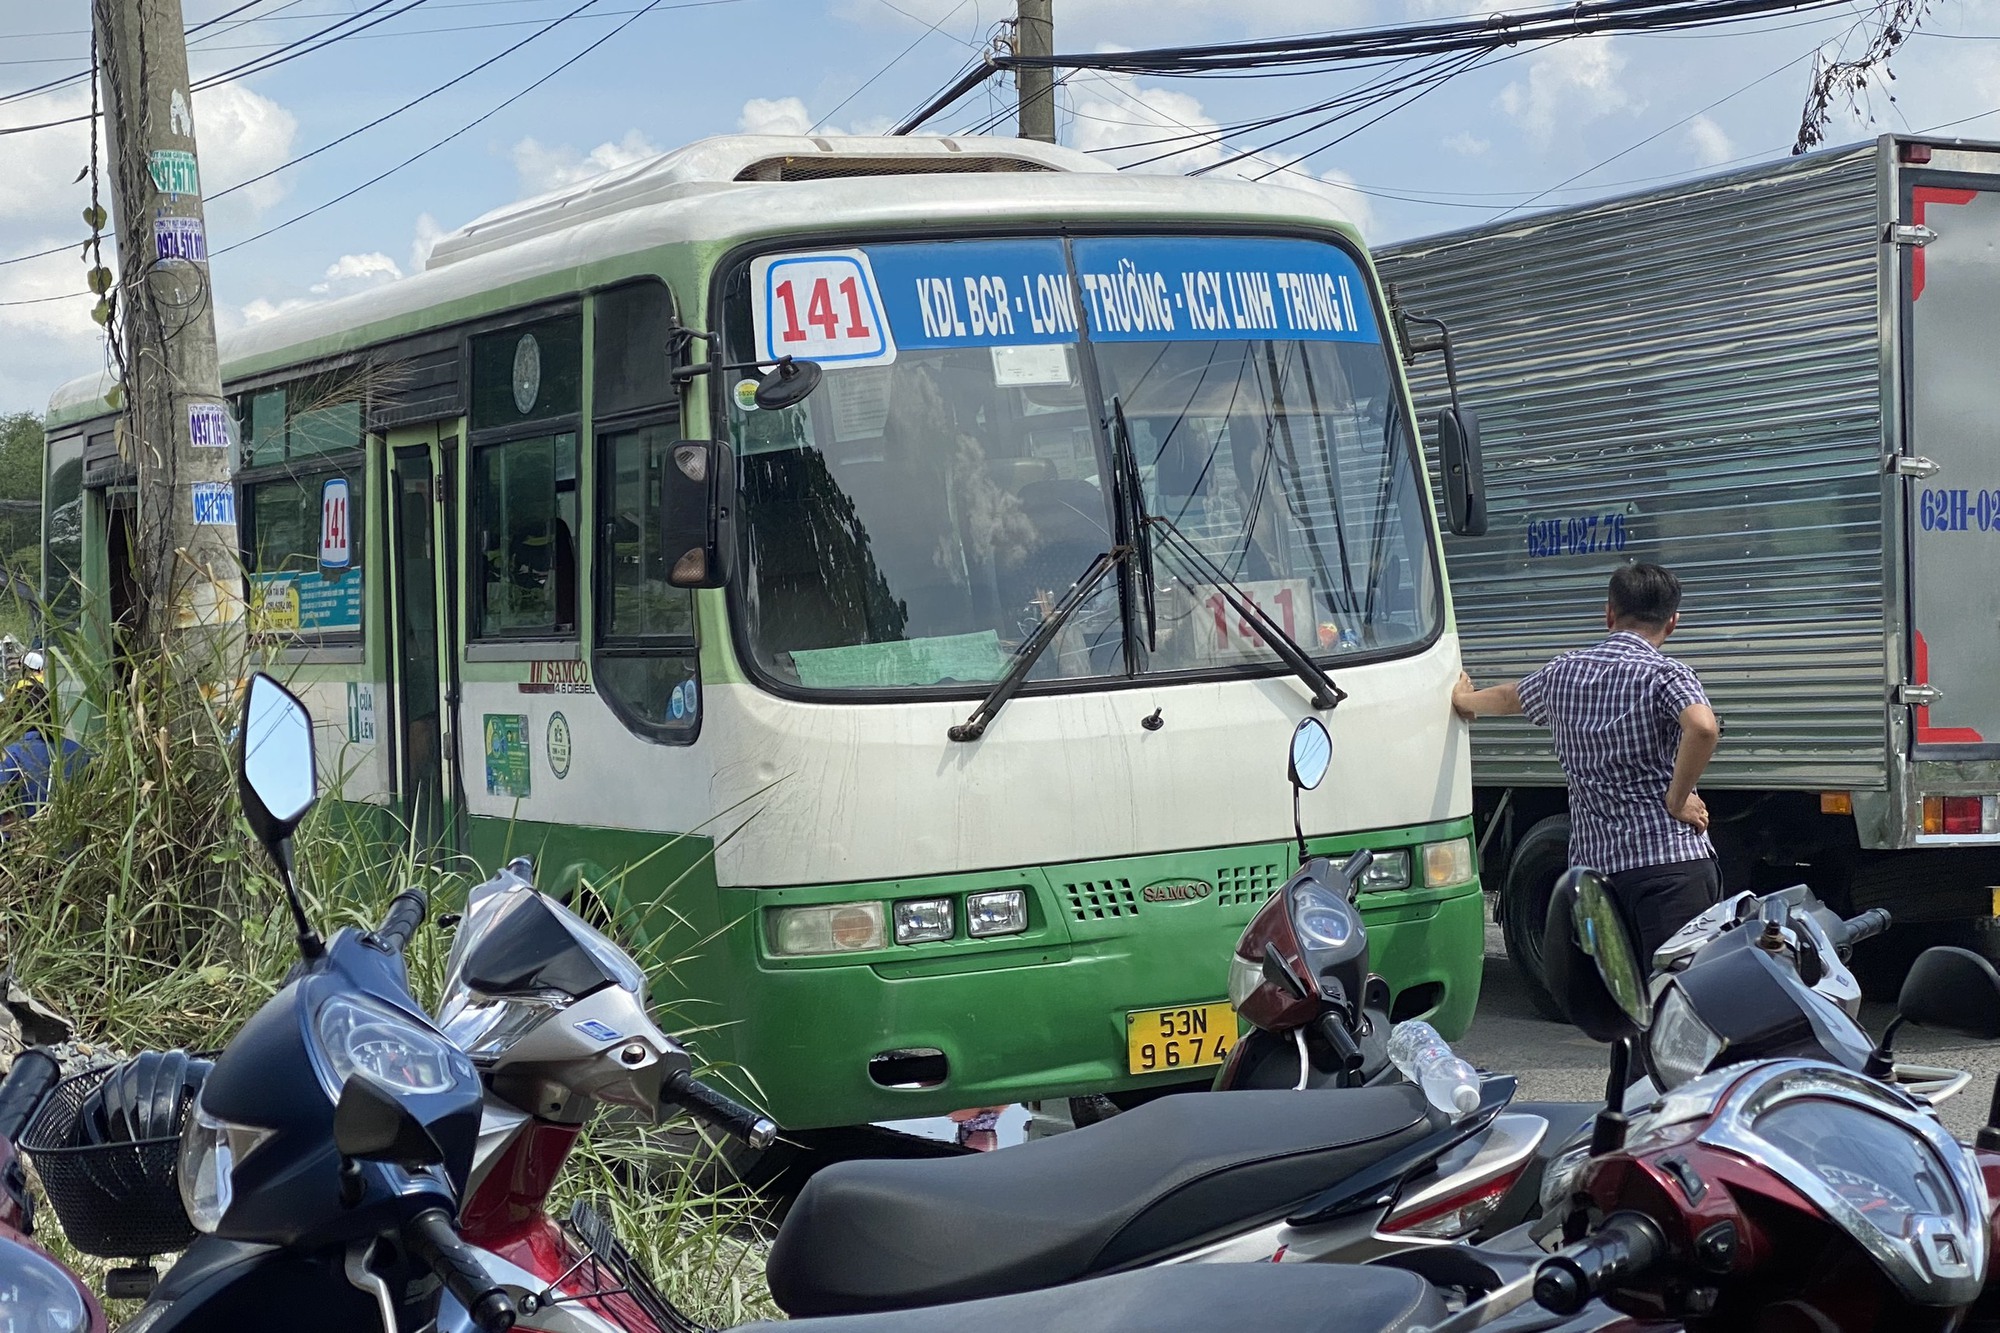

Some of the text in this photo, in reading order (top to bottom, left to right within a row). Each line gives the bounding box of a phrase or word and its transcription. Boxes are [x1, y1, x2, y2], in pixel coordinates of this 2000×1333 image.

[776, 277, 870, 342] 141
[916, 277, 967, 338] KDL
[963, 275, 1015, 336] BCR
[1083, 258, 1175, 332] TRƯỜNG
[1181, 271, 1231, 331] KCX
[1226, 272, 1278, 330] LINH
[1276, 273, 1344, 332] TRUNG
[1338, 275, 1358, 332] II
[324, 498, 346, 548] 141
[1528, 514, 1626, 557] 62H-027.76
[1205, 589, 1296, 649] 141
[547, 661, 588, 683] SAMCO
[1143, 882, 1211, 902] SAMCO
[1160, 1008, 1207, 1038] 53N
[1141, 1036, 1227, 1069] 9674
